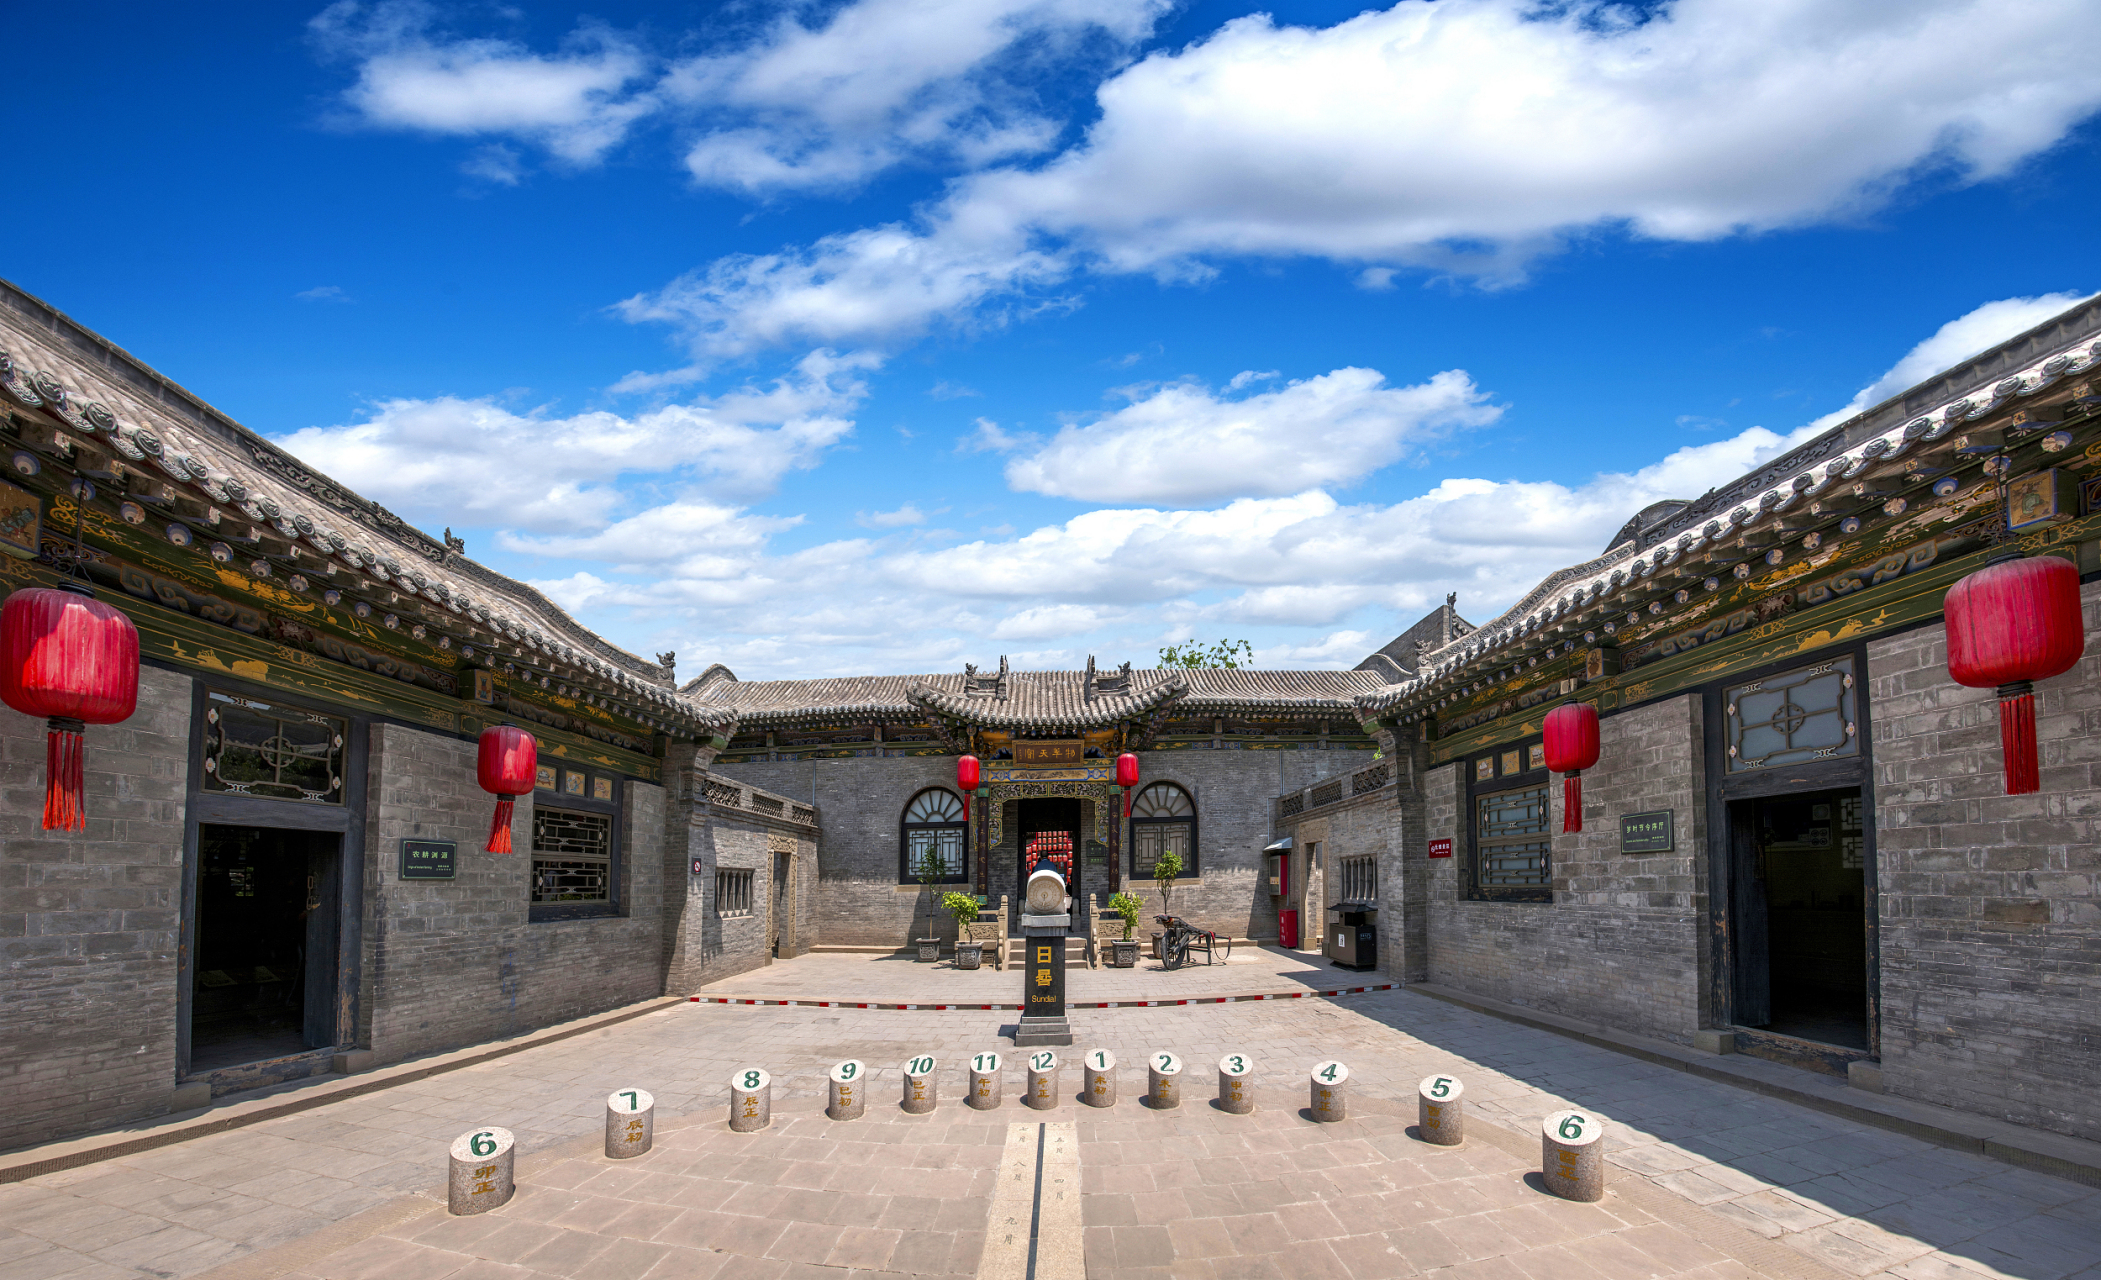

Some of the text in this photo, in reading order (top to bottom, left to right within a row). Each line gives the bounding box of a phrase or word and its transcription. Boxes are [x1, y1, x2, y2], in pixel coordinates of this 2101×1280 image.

[1031, 994, 1057, 1003] Sundial
[909, 1056, 934, 1074] 10
[974, 1054, 996, 1071] 11
[1031, 1051, 1054, 1070] 12
[1095, 1051, 1105, 1068] 1
[1159, 1054, 1174, 1072] 2
[1229, 1055, 1245, 1073] 3
[744, 1070, 760, 1089] 8
[840, 1062, 857, 1080] 9
[1320, 1063, 1337, 1082] 4
[1430, 1077, 1453, 1098] 5
[619, 1091, 637, 1111] 7
[1558, 1114, 1586, 1140] 6
[470, 1131, 497, 1156] 6
[1013, 1160, 1026, 1181] 八月
[1003, 1216, 1018, 1246] 九月
